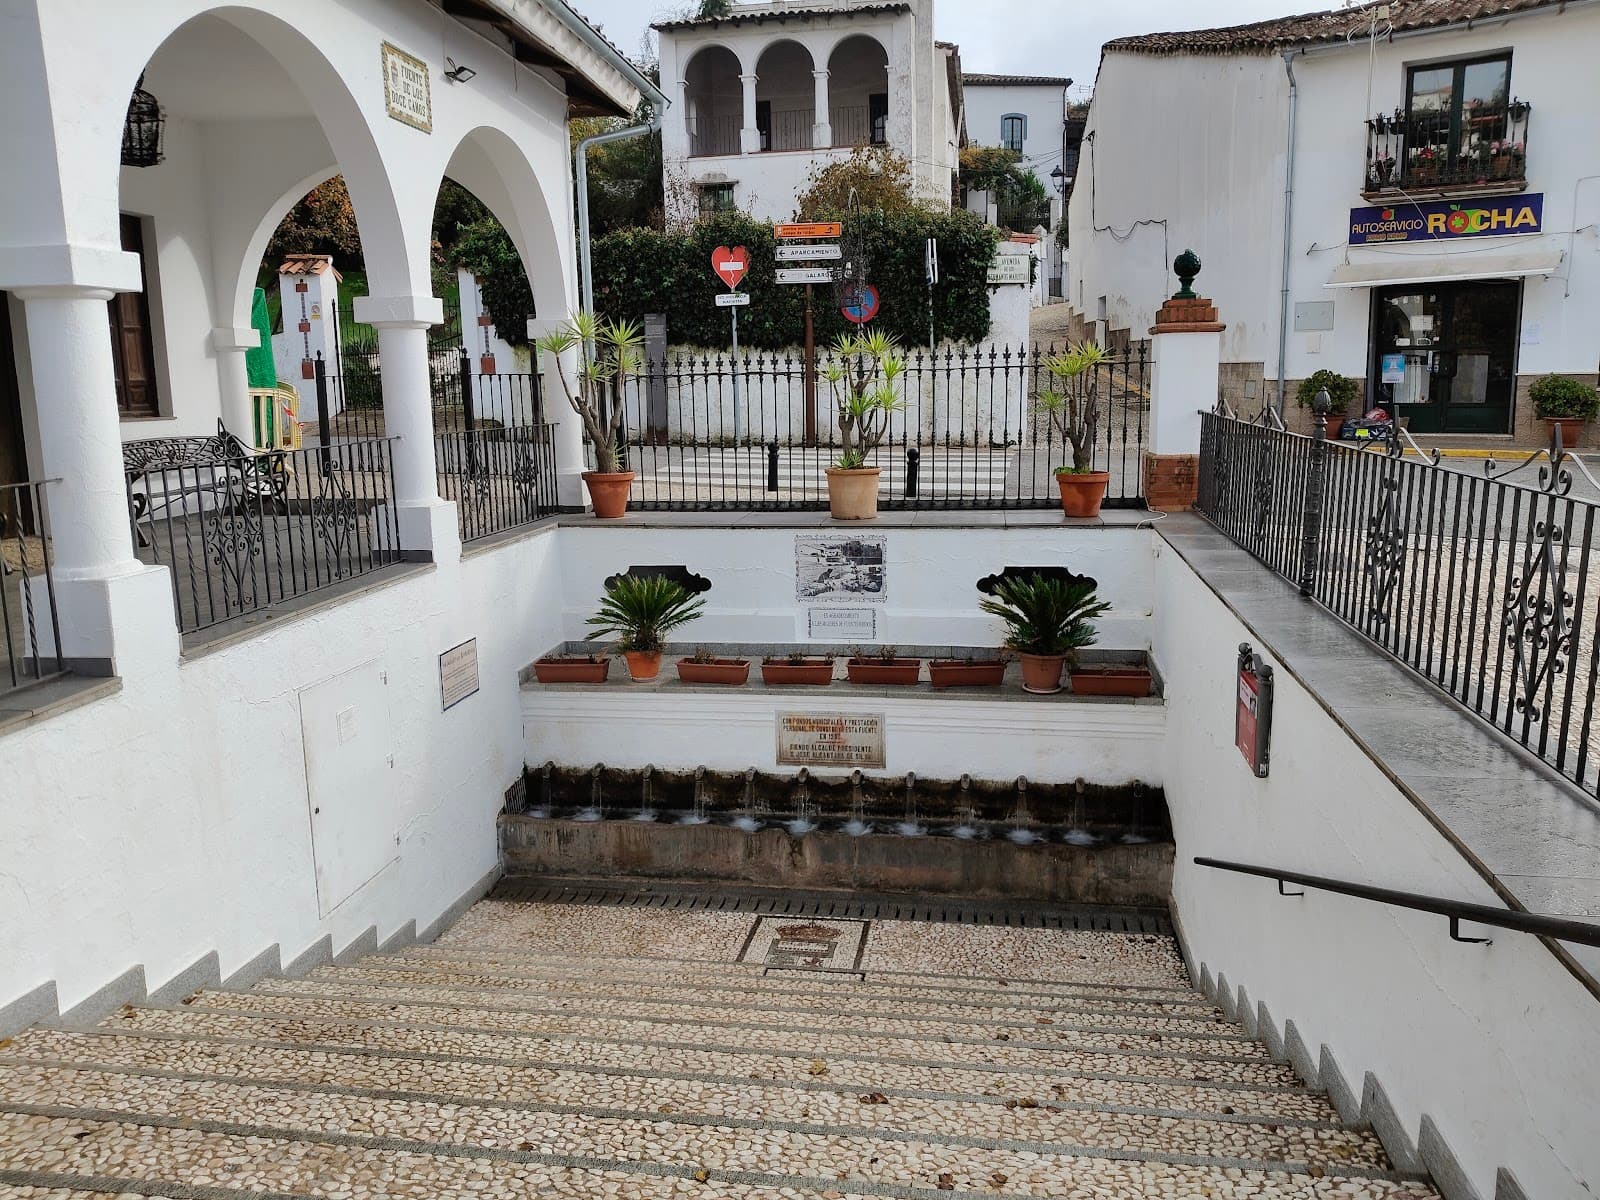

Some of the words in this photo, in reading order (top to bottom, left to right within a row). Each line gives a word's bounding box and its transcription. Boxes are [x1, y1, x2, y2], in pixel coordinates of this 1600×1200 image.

[400, 64, 423, 87] FUENTE
[391, 89, 407, 109] DOCE
[402, 80, 411, 96] DE
[412, 85, 423, 101] LOS
[1352, 219, 1424, 234] AUTOSERVICIO
[1427, 206, 1538, 234] ROCHA
[790, 248, 838, 256] APARCAMIENTO
[811, 743, 836, 752] ALCALDE
[837, 744, 872, 753] PRESIDENTE
